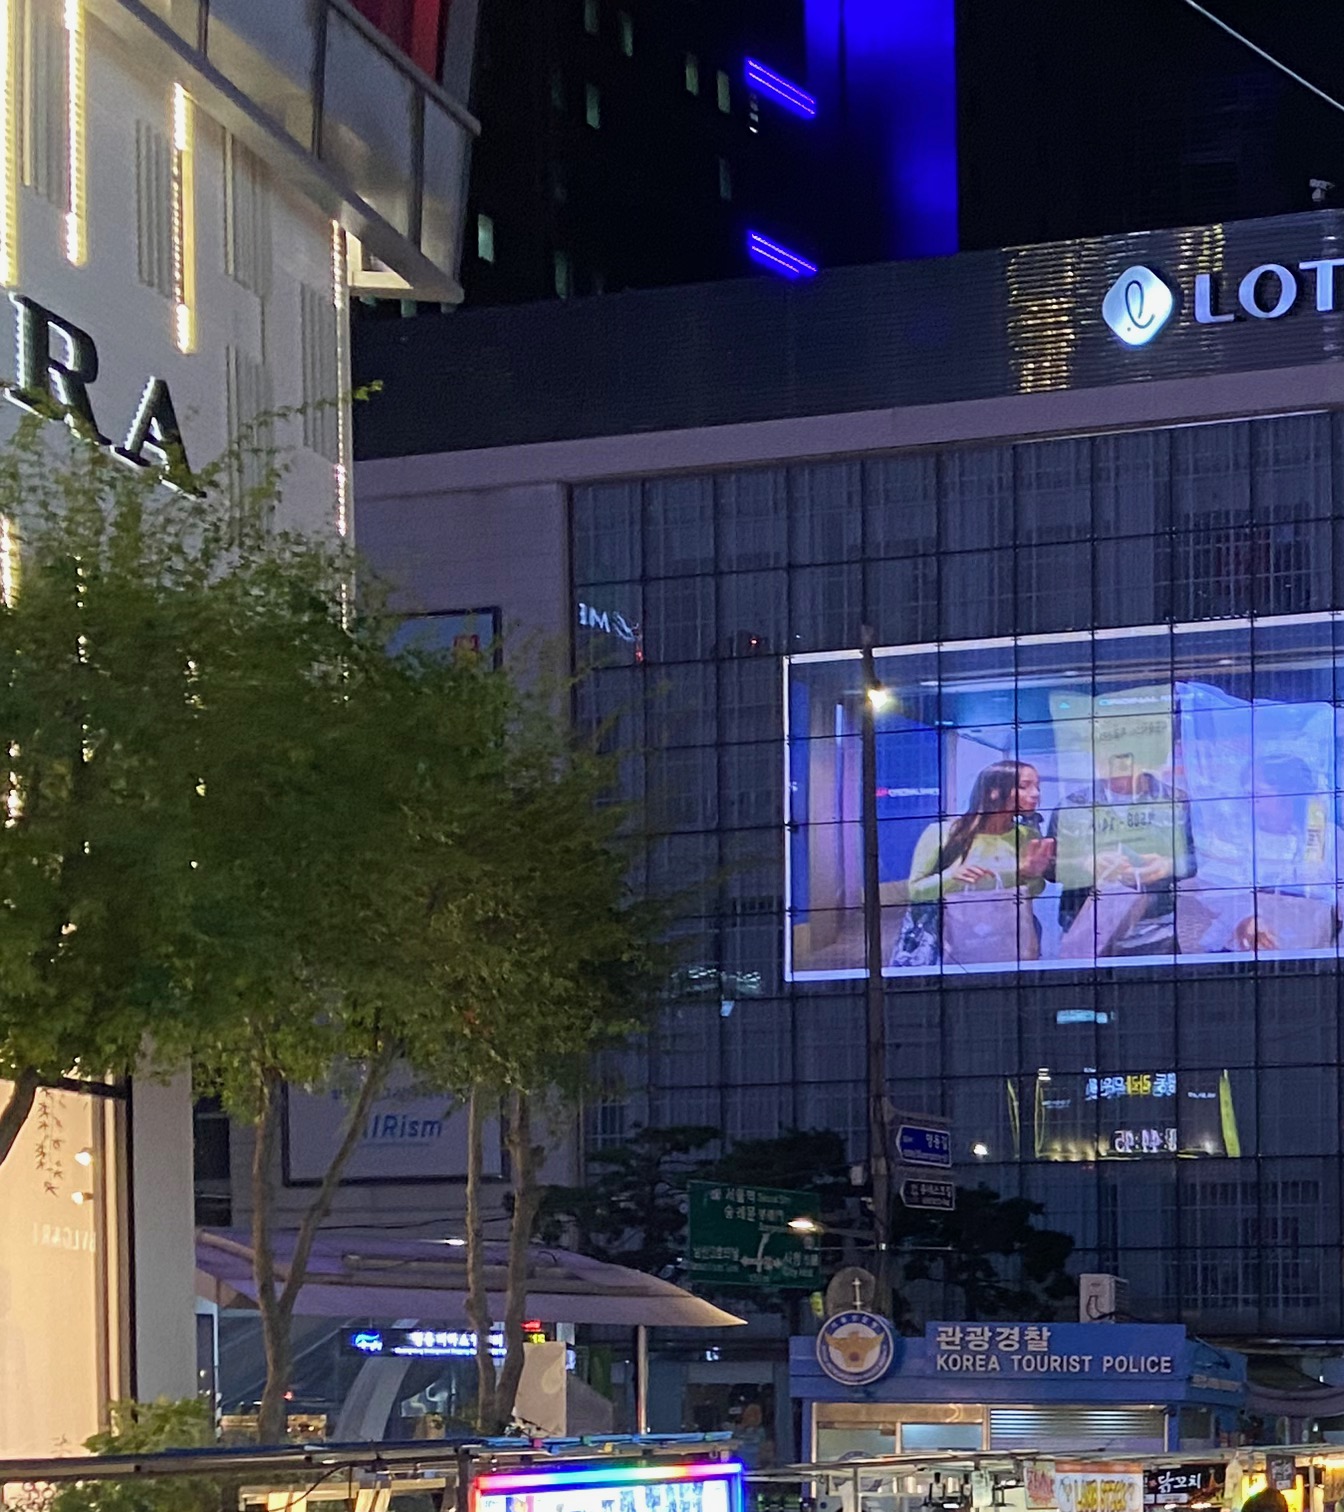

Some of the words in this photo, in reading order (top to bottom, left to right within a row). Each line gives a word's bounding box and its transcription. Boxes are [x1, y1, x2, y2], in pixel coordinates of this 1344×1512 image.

[935, 1325, 1051, 1352] 관광경찰
[935, 1354, 1000, 1373] KOREA
[1011, 1354, 1093, 1373] TOURIST
[1101, 1354, 1172, 1373] POLICE
